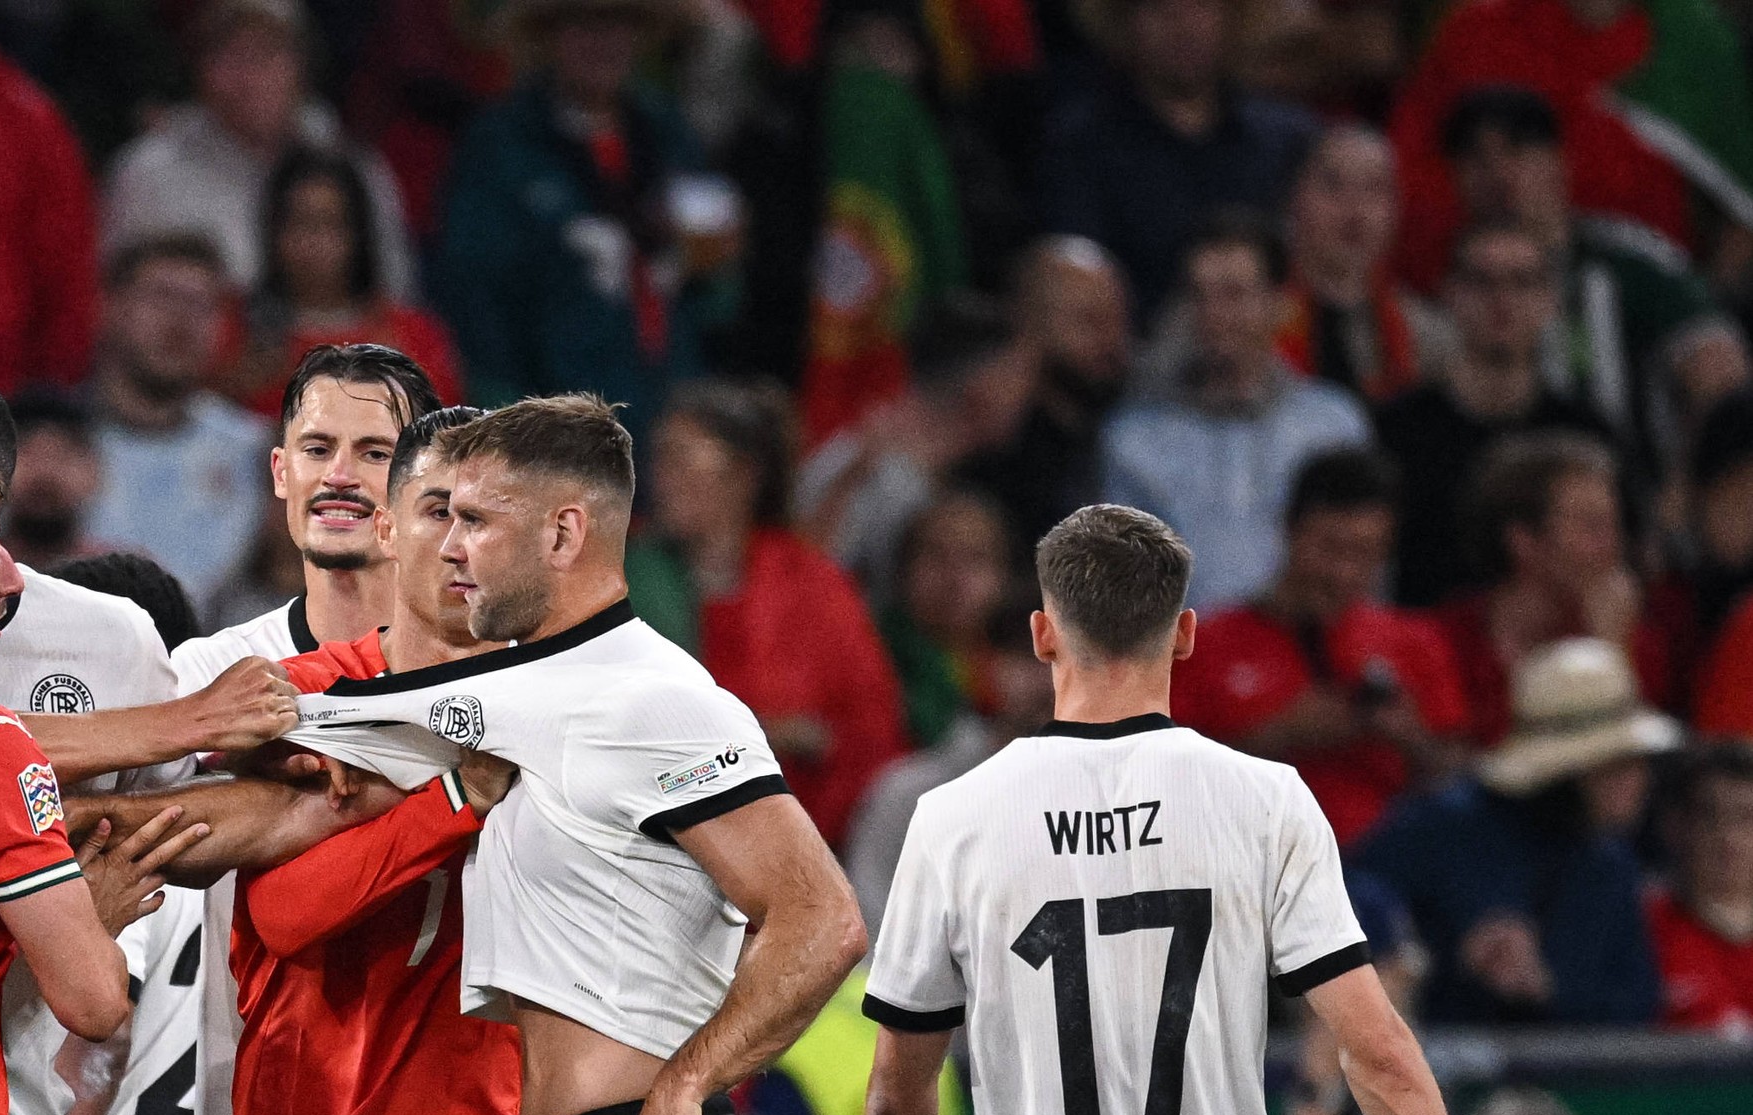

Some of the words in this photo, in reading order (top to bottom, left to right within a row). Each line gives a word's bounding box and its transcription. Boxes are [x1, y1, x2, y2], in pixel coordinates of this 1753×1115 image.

[715, 746, 739, 770] 10
[660, 762, 717, 792] FOUNDATION
[1044, 800, 1163, 855] WIRTZ
